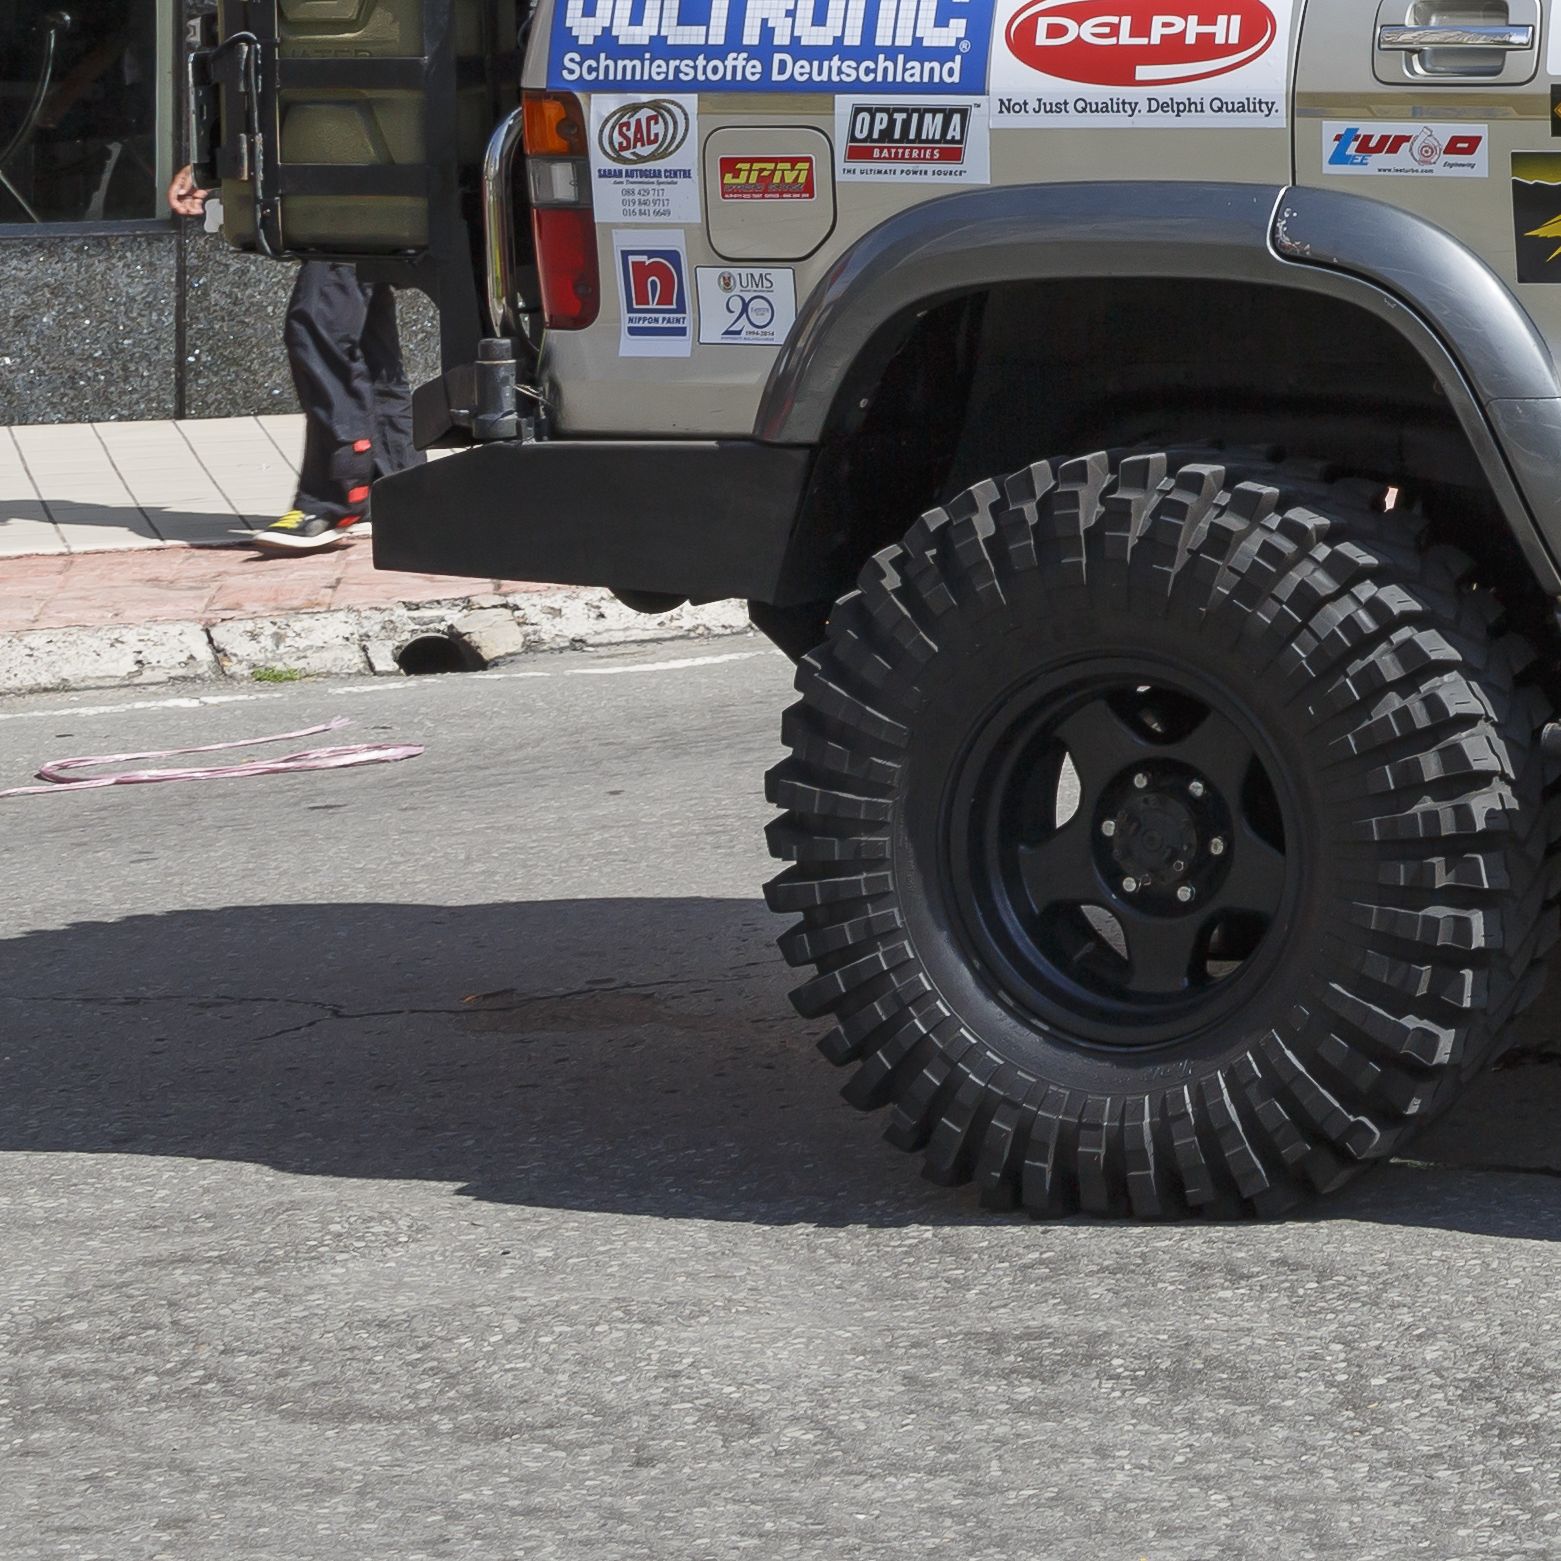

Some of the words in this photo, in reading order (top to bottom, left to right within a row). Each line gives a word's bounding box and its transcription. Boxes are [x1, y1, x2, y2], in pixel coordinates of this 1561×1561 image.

[1035, 14, 1242, 46] DELPHI
[562, 52, 762, 82] Schmierstoffe
[771, 53, 961, 85] Deutschland
[998, 98, 1030, 115] Not
[1033, 98, 1070, 116] Just
[1073, 97, 1142, 118] Quality.
[1146, 97, 1206, 118] Delphi
[1209, 97, 1279, 118] Quality.
[617, 113, 660, 153] SAC
[854, 111, 962, 142] OPTIMA
[873, 147, 941, 161] BATTERIES
[597, 168, 623, 179] SABAH
[664, 168, 693, 179] CENTRE
[723, 162, 810, 184] JPM
[842, 168, 857, 176] THE
[859, 168, 898, 177] ULTIMATE
[900, 168, 928, 177] POWER
[621, 188, 636, 197] 088
[651, 188, 665, 197] 717
[621, 198, 636, 207] 019
[651, 198, 670, 207] 9717
[622, 208, 637, 217] 016
[638, 208, 651, 217] 841
[737, 272, 774, 289] UMS
[628, 316, 659, 325] NIPPON
[661, 316, 687, 325] PAINT
[721, 294, 775, 336] 20
